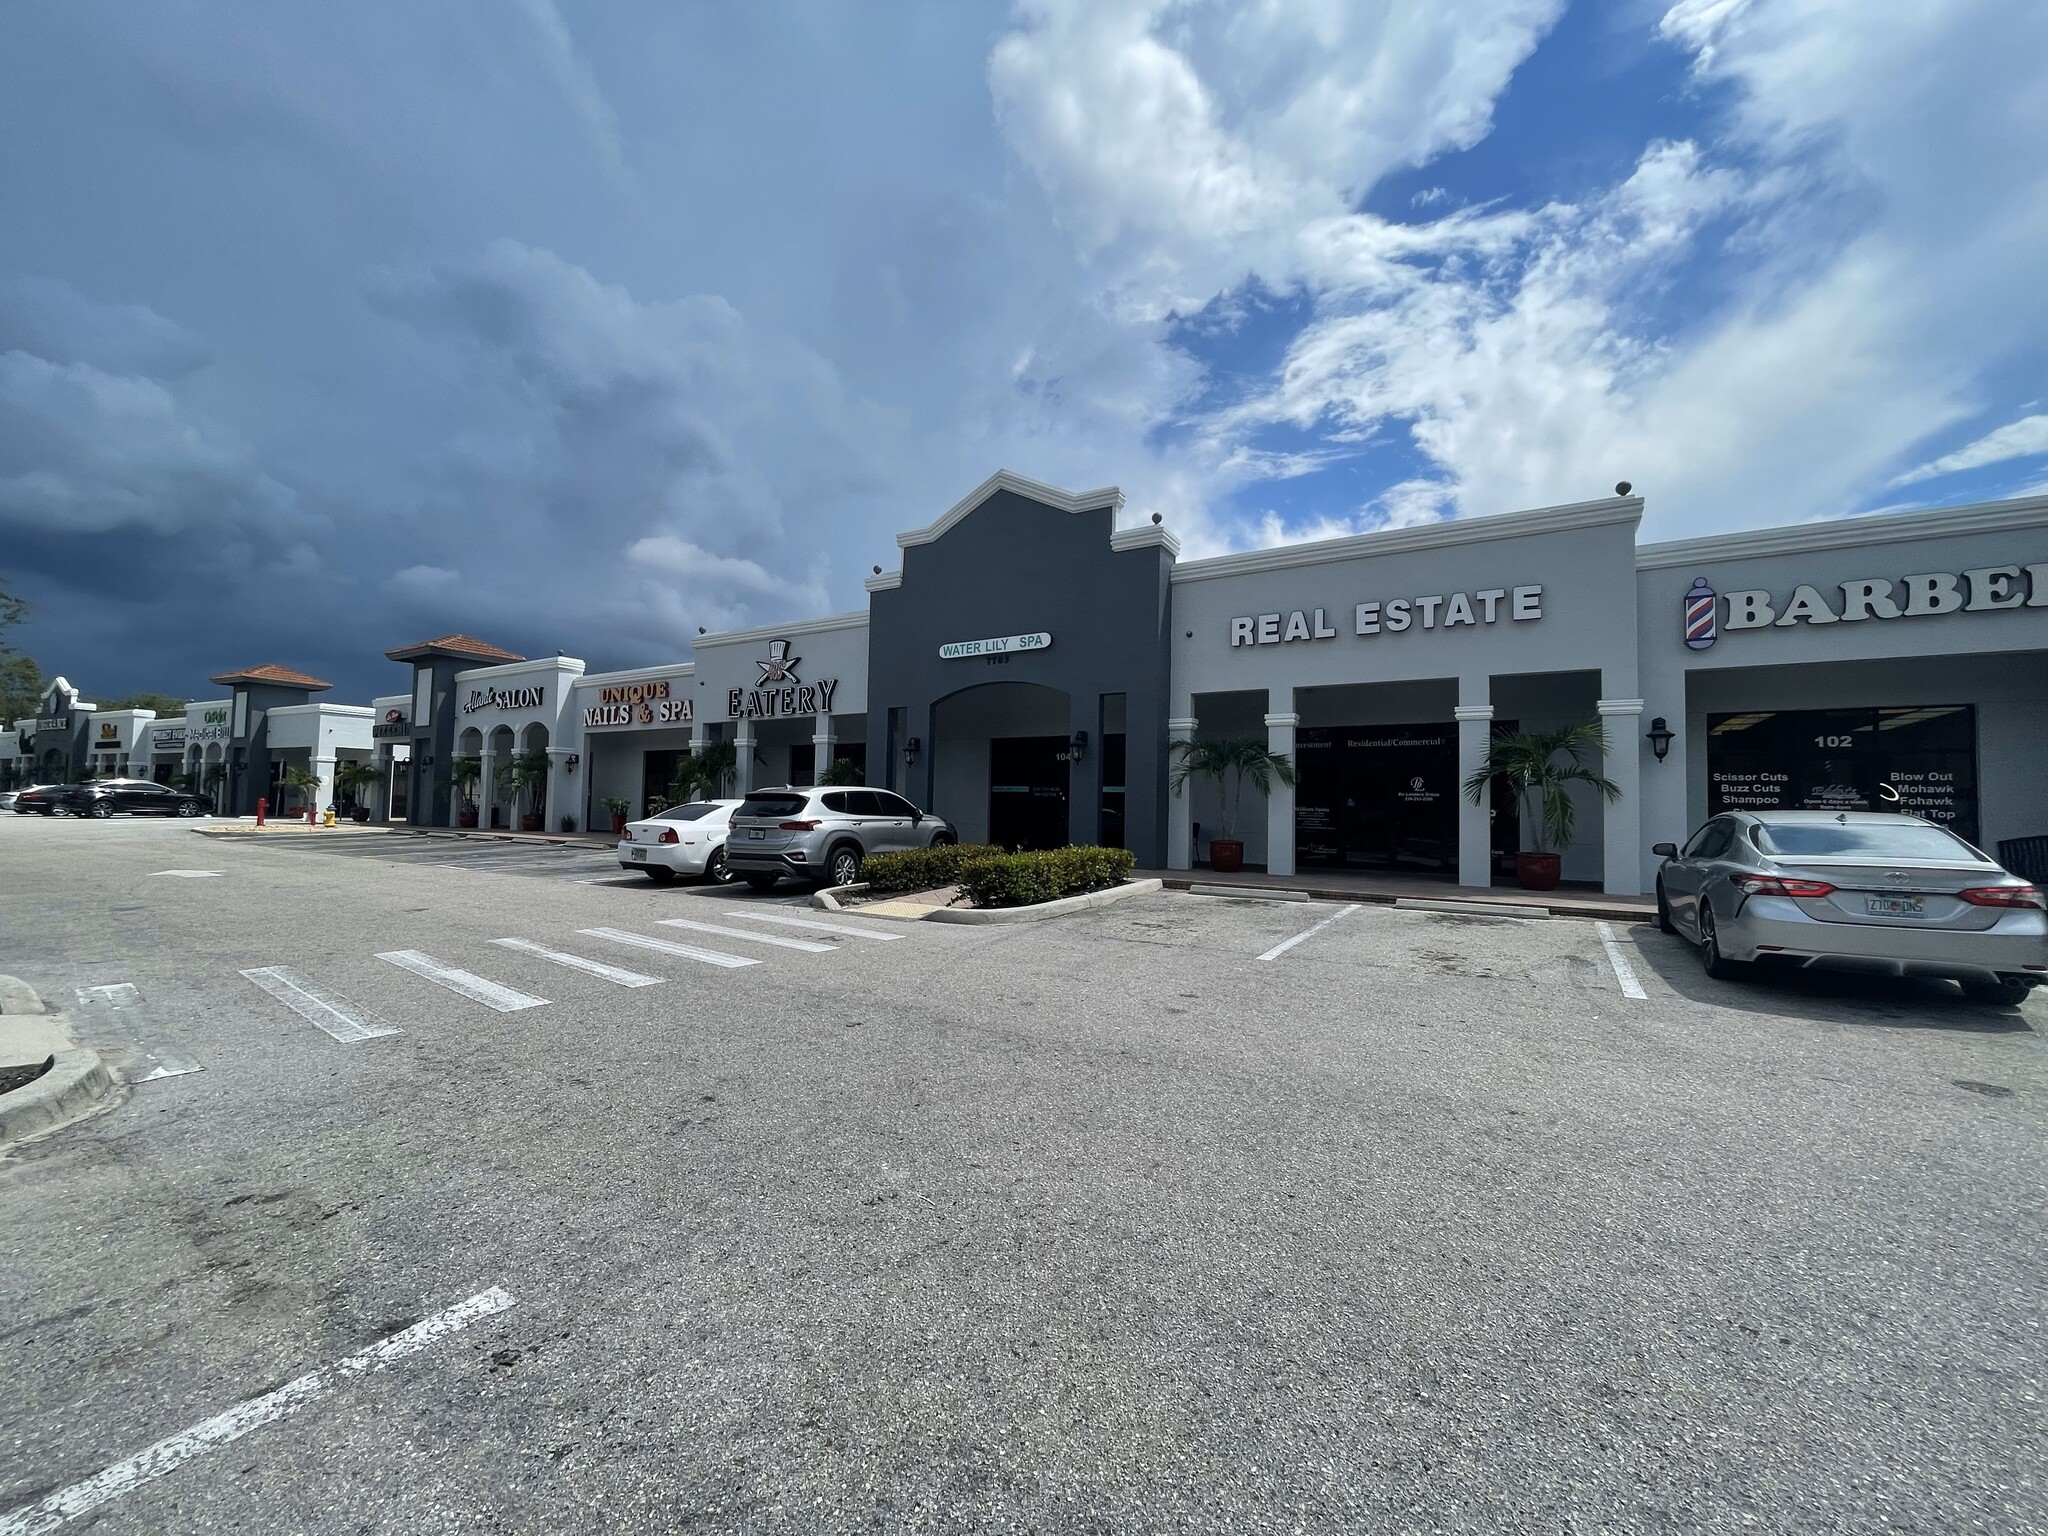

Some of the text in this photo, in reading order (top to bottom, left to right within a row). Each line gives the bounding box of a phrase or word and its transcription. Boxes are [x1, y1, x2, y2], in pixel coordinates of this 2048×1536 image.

[1231, 584, 1543, 647] REAL ESTATE
[943, 634, 1043, 656] WATER LILY SPA
[495, 687, 544, 710] SALON
[599, 682, 669, 704] UNIQUE
[727, 679, 839, 718] EATERY
[582, 699, 693, 727] NAILS & SPA
[1295, 738, 1441, 749] nvestment Residential/Commercial
[1814, 736, 1853, 748] 102
[1713, 773, 1789, 781] Scissor Cuts
[1890, 772, 1953, 781] Blow Out
[1721, 784, 1781, 793] Buzz Cuts
[1897, 784, 1954, 793] Mohawk
[1722, 795, 1779, 805] Shampoo
[1899, 796, 1954, 806] Fohawk
[1900, 808, 1956, 820] Flat Top
